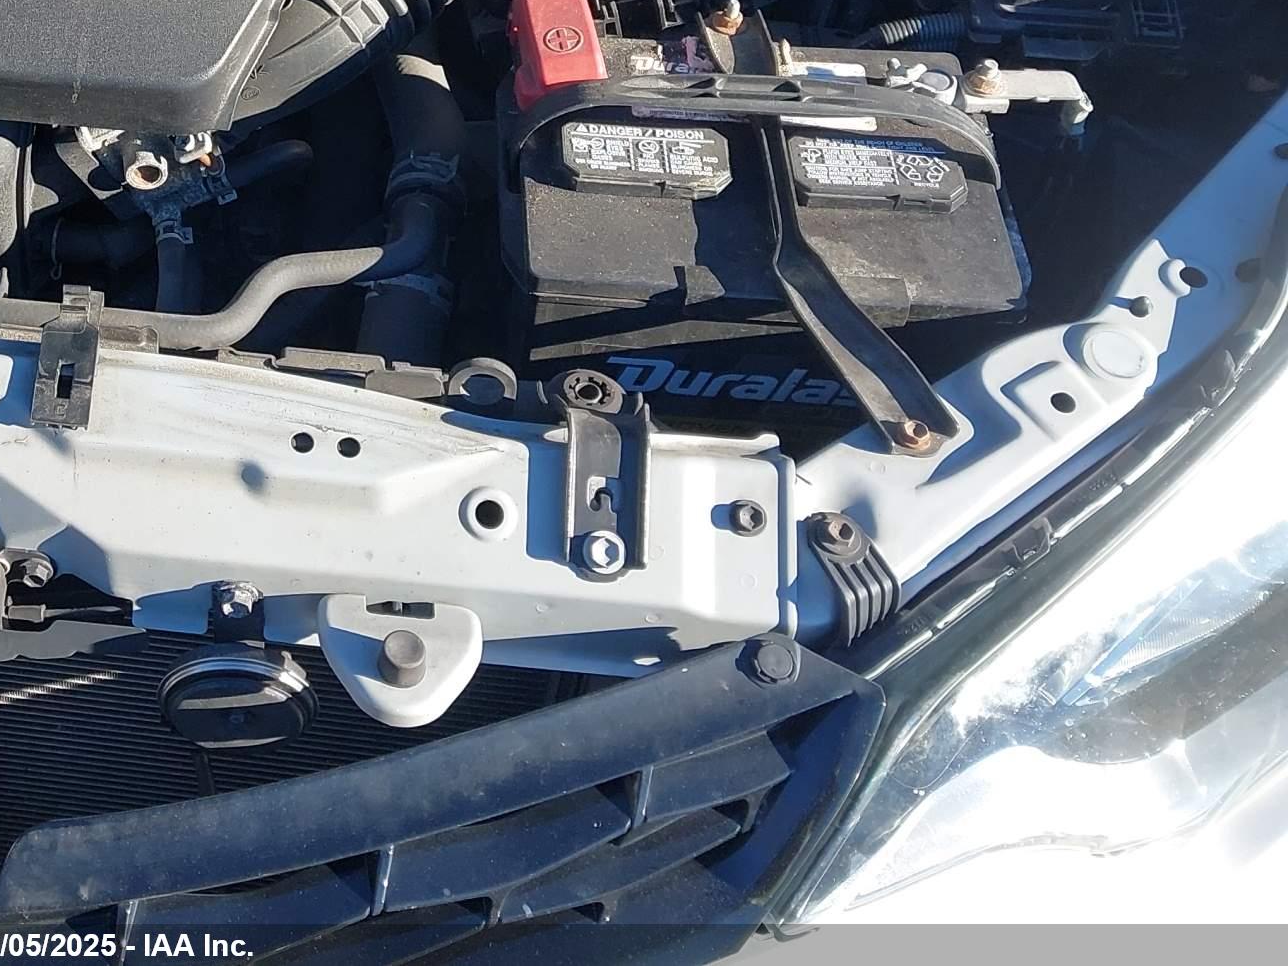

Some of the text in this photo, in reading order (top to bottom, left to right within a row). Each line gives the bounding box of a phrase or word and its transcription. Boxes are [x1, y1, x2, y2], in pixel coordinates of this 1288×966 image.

[589, 125, 704, 140] DANGER / POISON
[606, 356, 858, 407] Durala
